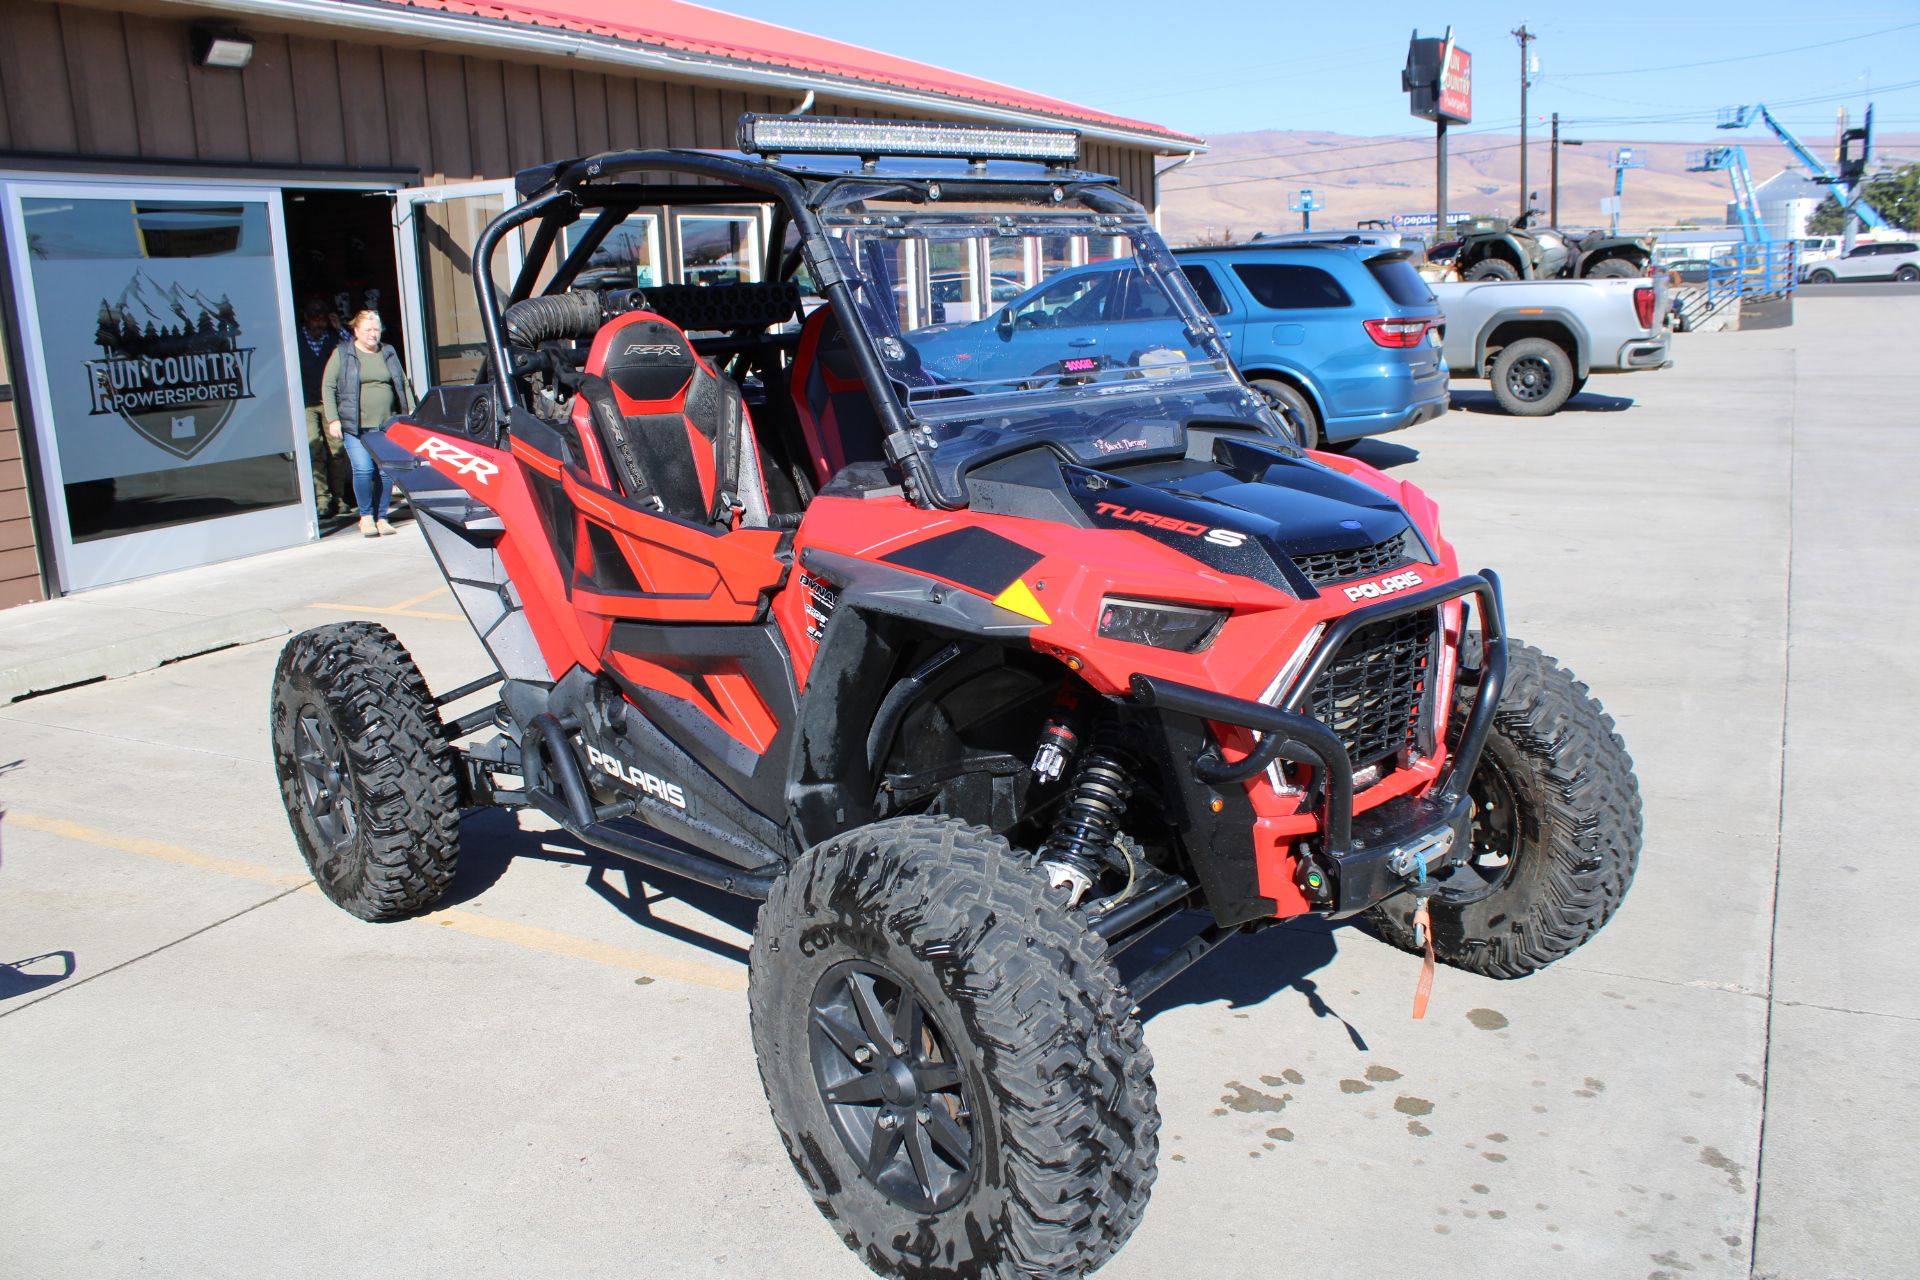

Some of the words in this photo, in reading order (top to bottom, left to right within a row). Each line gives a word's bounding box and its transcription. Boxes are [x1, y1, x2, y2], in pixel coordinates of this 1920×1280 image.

[1444, 72, 1470, 96] OUNTRY
[1403, 214, 1431, 226] pepsi
[624, 343, 681, 356] RZR
[80, 358, 144, 416] FUN
[149, 347, 257, 399] COUNTRY
[114, 383, 239, 410] POWERSPORTS
[414, 436, 499, 486] RZR
[1094, 501, 1210, 537] TURBO
[1204, 529, 1248, 547] S
[799, 573, 838, 605] DYNA
[1343, 570, 1423, 602] POLARIS
[586, 744, 686, 809] POLARIS
